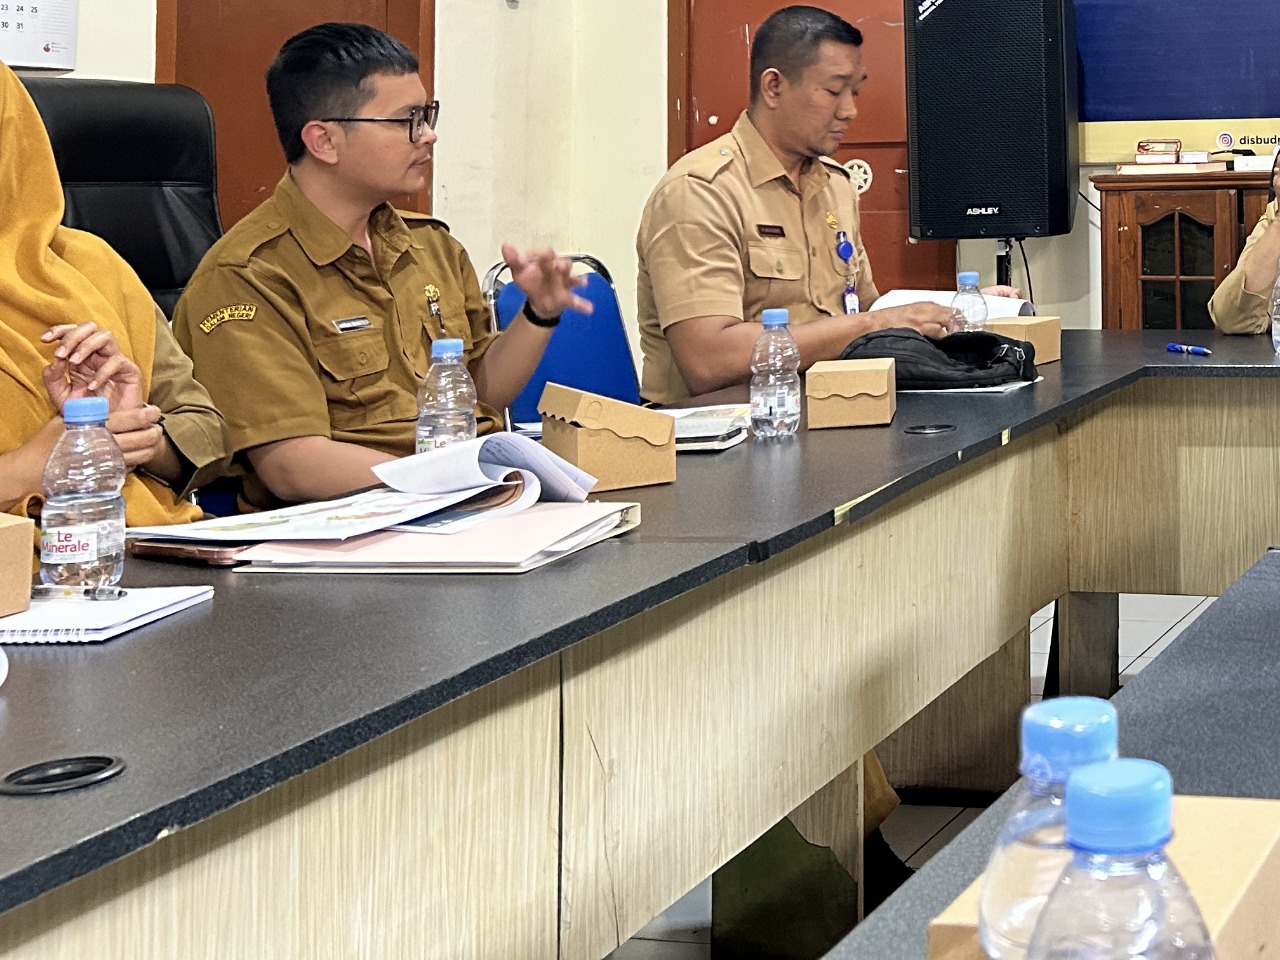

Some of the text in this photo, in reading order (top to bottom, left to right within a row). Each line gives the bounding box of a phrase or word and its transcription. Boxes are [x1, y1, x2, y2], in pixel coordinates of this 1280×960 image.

[16, 4, 24, 12] 24
[0, 21, 9, 29] 30
[966, 207, 1000, 215] ASHLEY
[434, 439, 447, 449] Le
[57, 531, 73, 542] Le
[42, 540, 90, 553] Minerale
